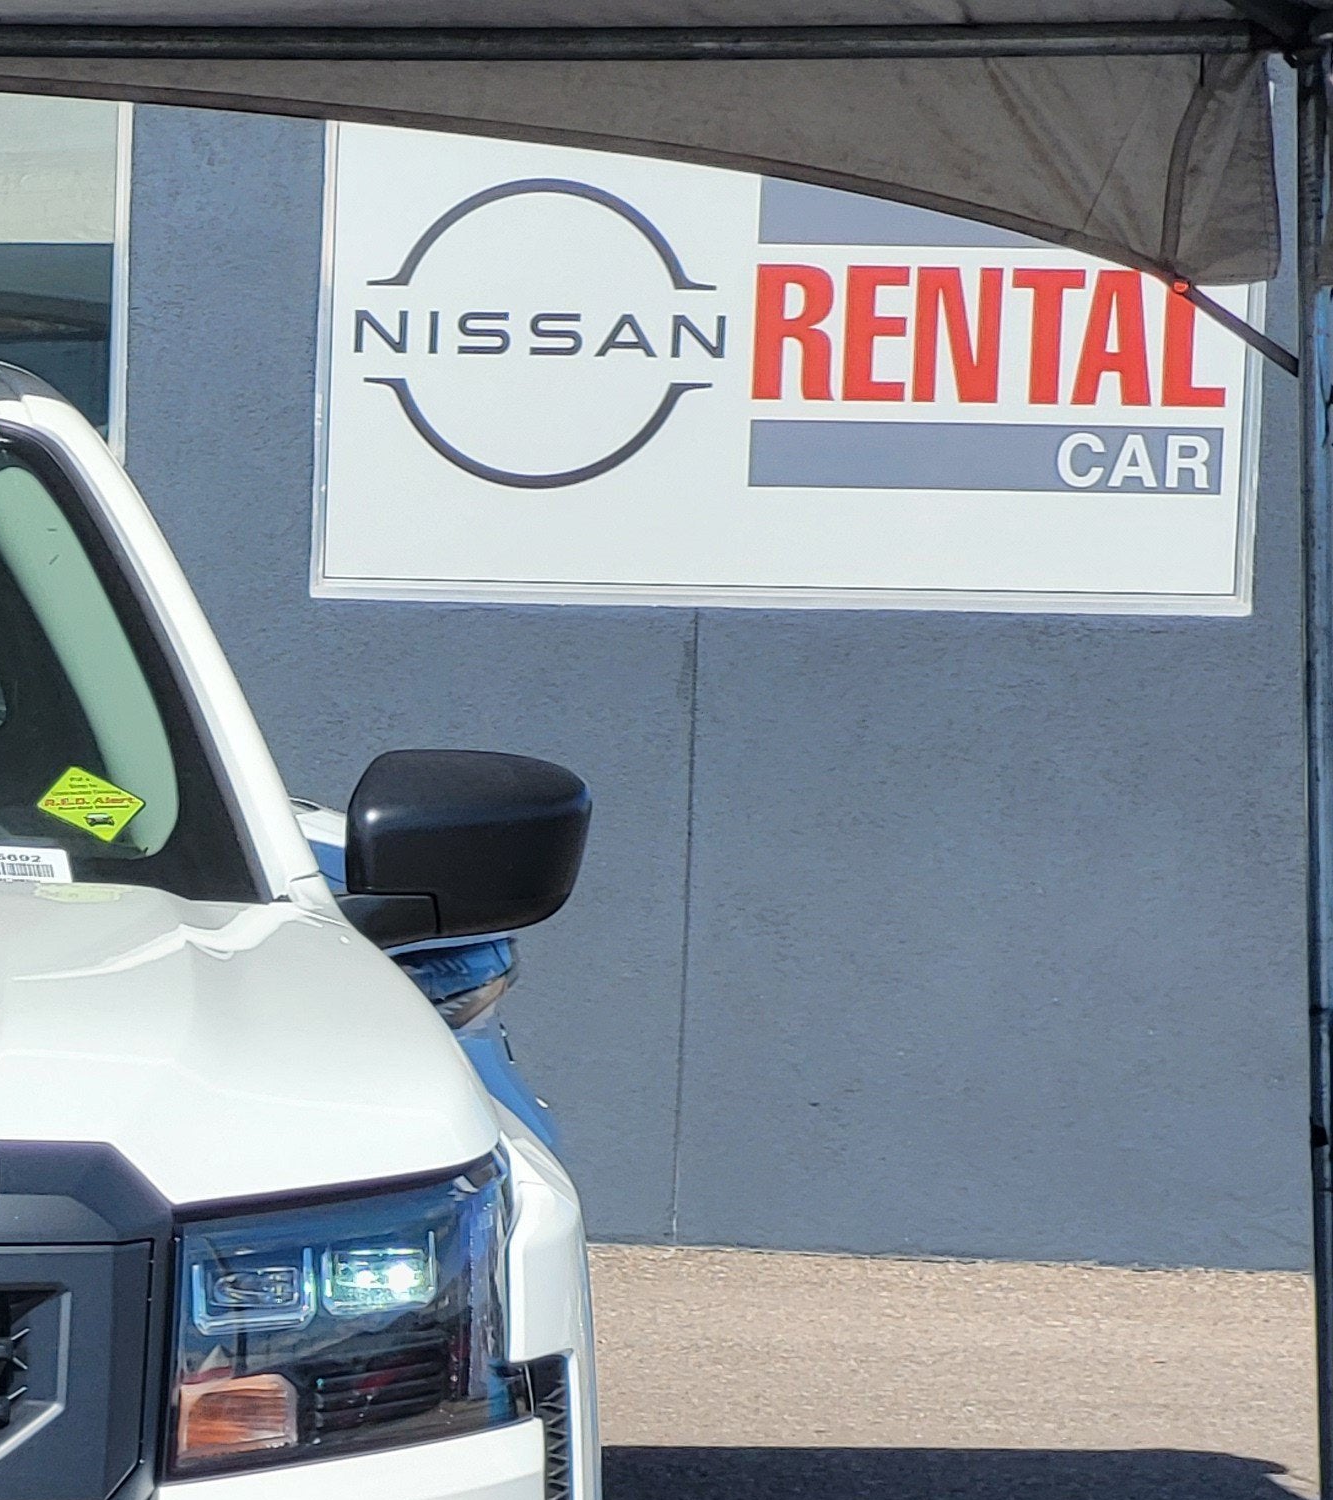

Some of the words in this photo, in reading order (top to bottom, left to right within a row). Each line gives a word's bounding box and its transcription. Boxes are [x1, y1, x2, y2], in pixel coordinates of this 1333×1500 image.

[353, 309, 726, 359] NISSAN
[750, 263, 1226, 407] RENTAL
[1056, 432, 1210, 490] CAR
